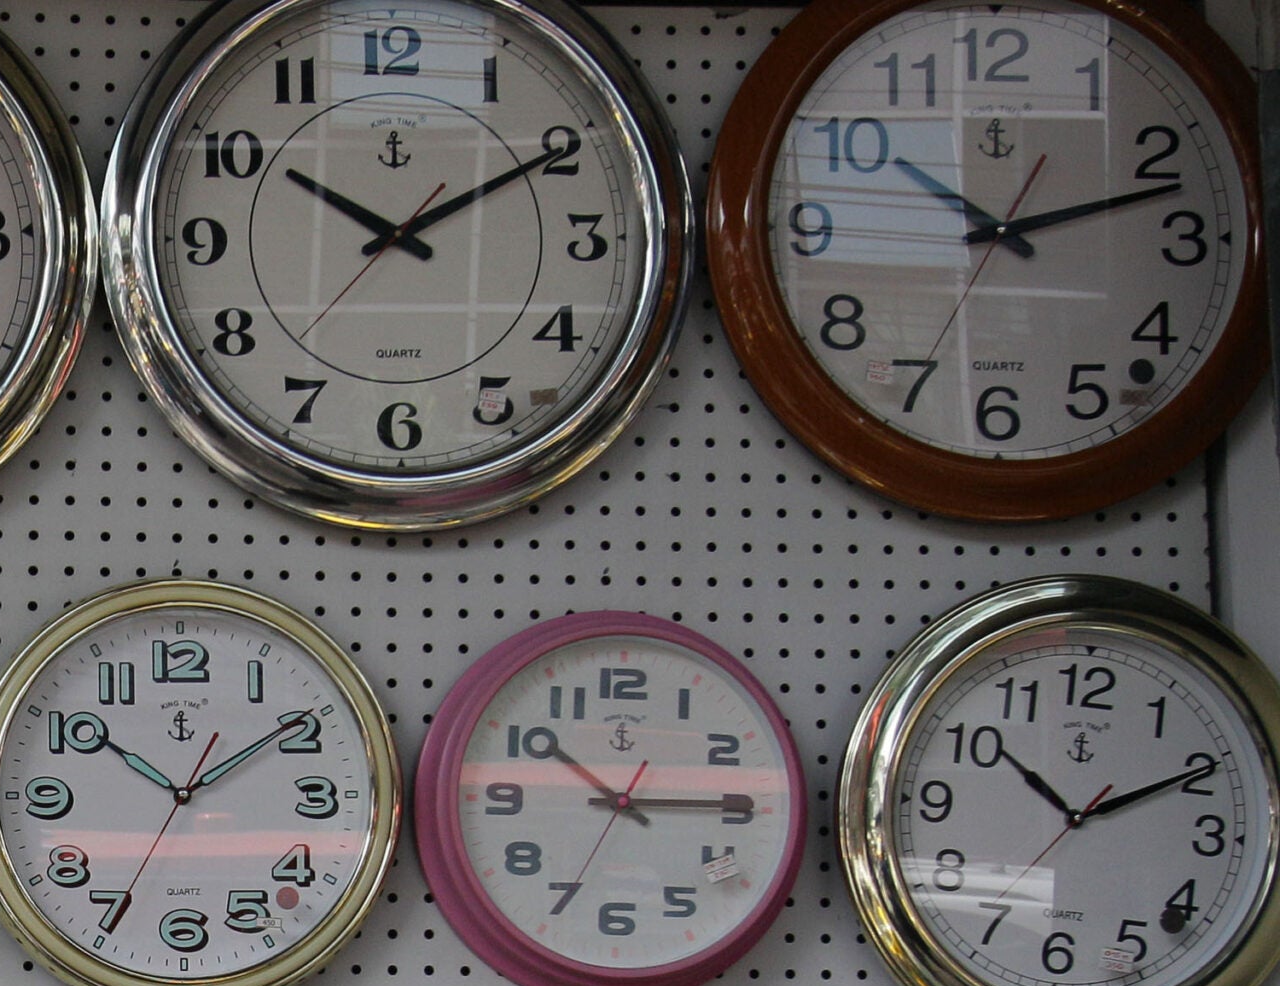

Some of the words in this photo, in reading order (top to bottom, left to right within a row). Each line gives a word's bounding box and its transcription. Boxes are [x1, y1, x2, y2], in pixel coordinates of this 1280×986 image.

[363, 26, 421, 77] 12
[953, 28, 1030, 83] 12
[275, 56, 316, 104] 11
[874, 53, 935, 107] 11
[370, 118, 393, 129] KING
[398, 118, 418, 128] TIME
[203, 129, 263, 179] 10
[813, 117, 889, 174] 10
[1134, 125, 1181, 179] 2
[182, 217, 228, 265] 9
[1162, 211, 1208, 266] 3
[213, 308, 256, 356] 8
[376, 350, 421, 359] QUARTZ
[973, 361, 1024, 372] QUARTZ
[152, 640, 209, 683] 12
[160, 701, 178, 710] KING
[182, 700, 201, 709] TIME
[599, 668, 648, 700] 12
[996, 677, 1040, 723] 11
[1059, 663, 1116, 710] 12
[707, 734, 740, 766] 2
[947, 723, 1003, 768] 10
[25, 776, 74, 819] 9
[294, 776, 339, 819] 3
[920, 781, 953, 823] 9
[1192, 815, 1225, 857] 3
[272, 844, 315, 886] 4
[504, 841, 542, 876] 8
[167, 888, 201, 896] QUARTZ
[663, 886, 696, 917] 5
[159, 909, 209, 952] 6
[598, 902, 636, 936] 6
[1043, 909, 1084, 921] QUARTZ
